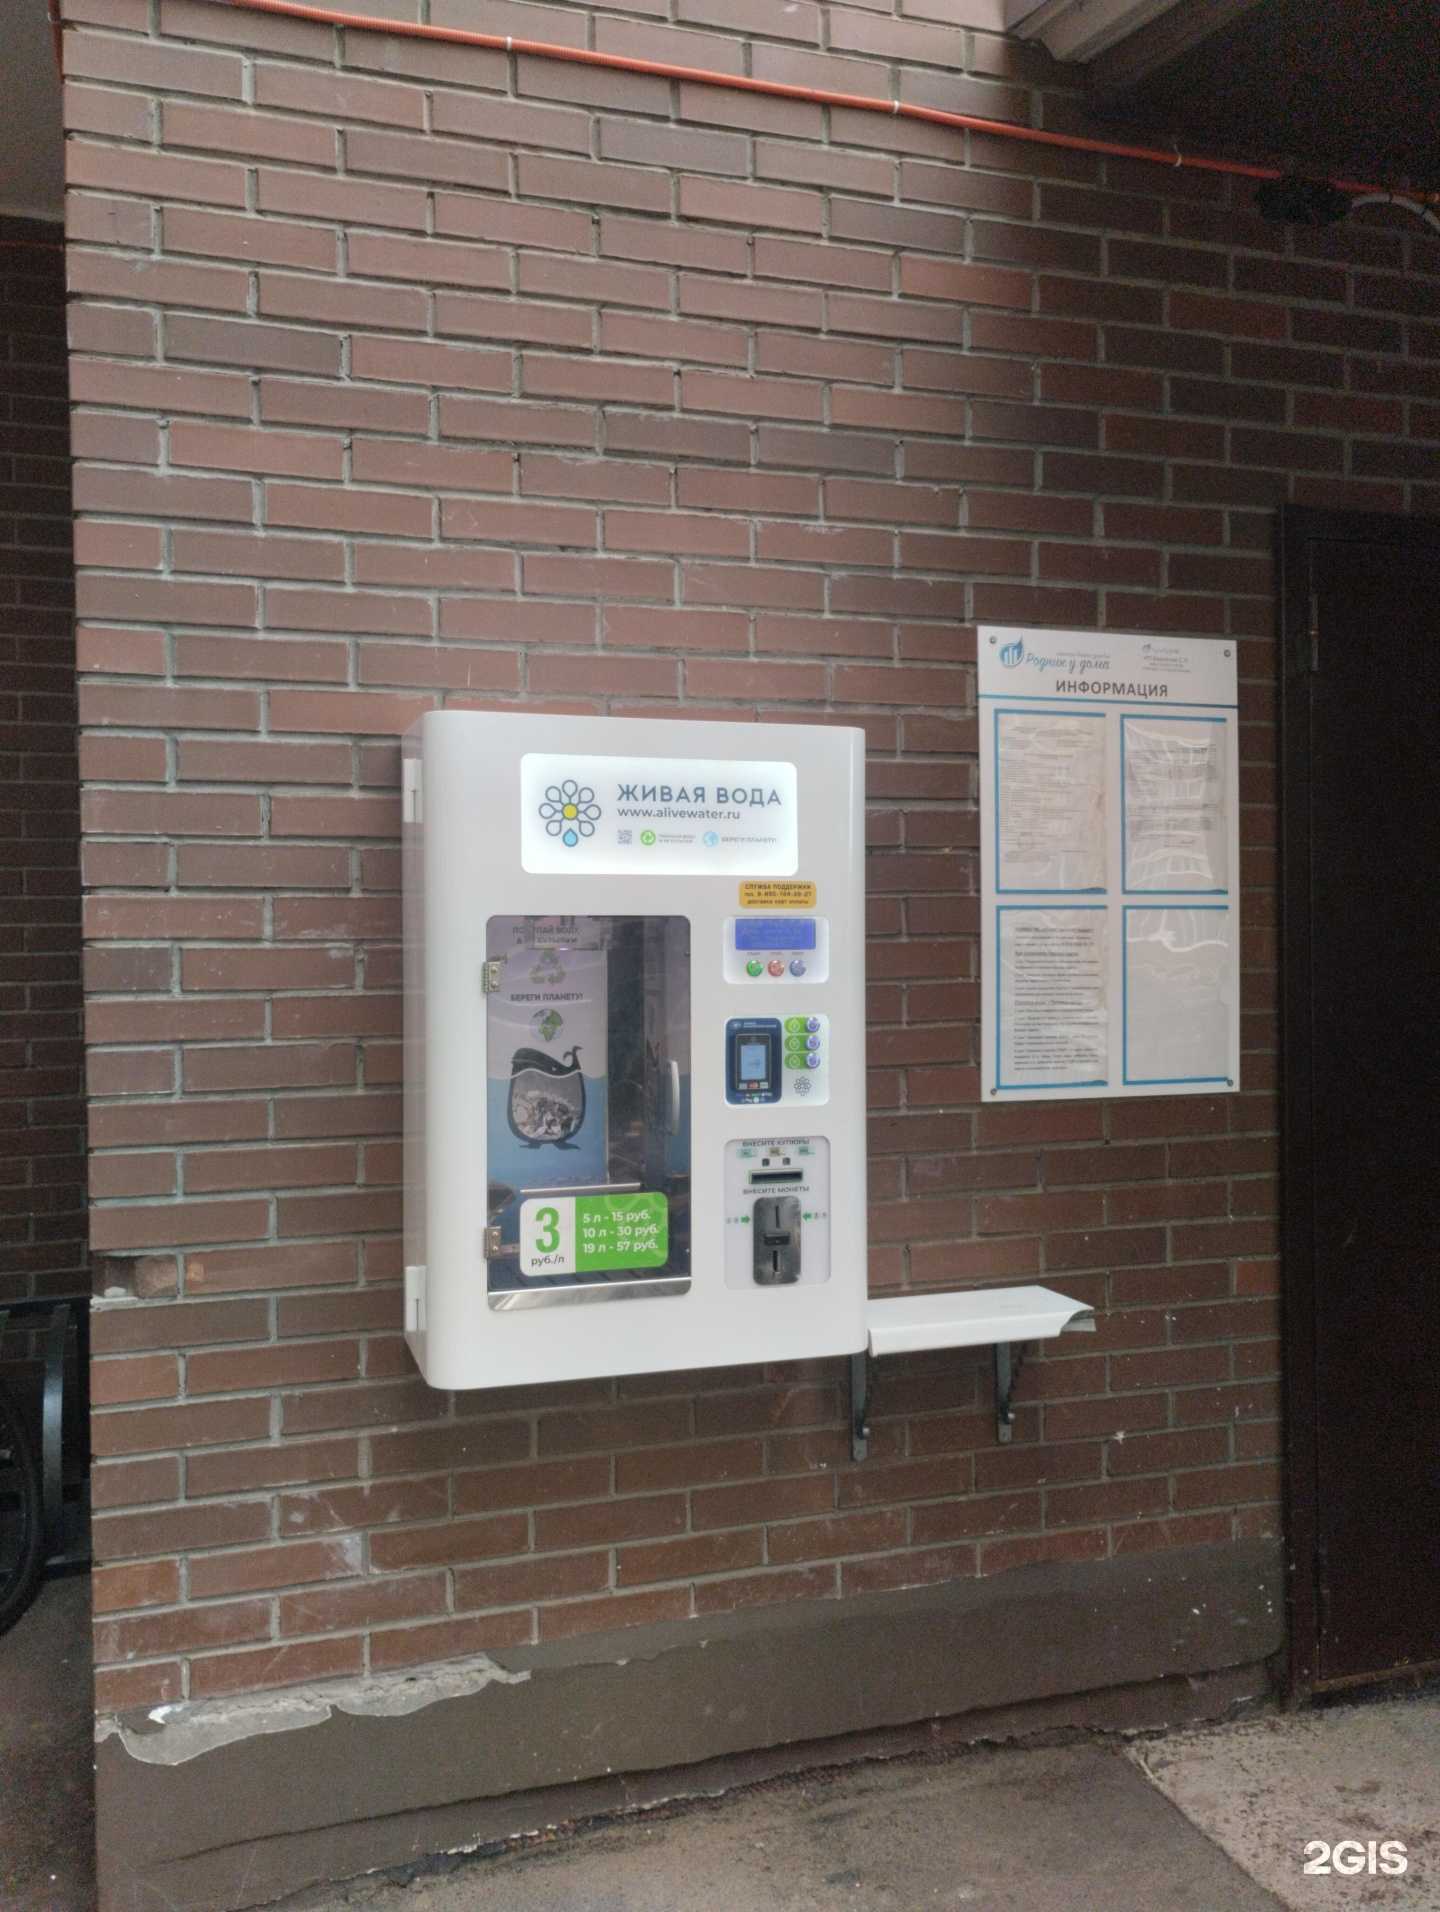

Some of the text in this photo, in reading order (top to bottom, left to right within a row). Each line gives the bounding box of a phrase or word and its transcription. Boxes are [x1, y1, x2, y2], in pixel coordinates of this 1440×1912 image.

[1056, 679, 1169, 699] ИНФОРМАЦИЯ
[617, 783, 782, 808] ЖИВАЯ ВОДА
[617, 807, 741, 820] www.alivewater.ru
[510, 992, 584, 1001] БЕРЕГИ ПЛАНЕТУ!
[583, 1213, 590, 1223] 5
[612, 1211, 623, 1222] 15
[626, 1210, 651, 1223] руб.
[535, 1207, 561, 1253] 3
[583, 1227, 596, 1238] 10
[617, 1225, 632, 1236] 30
[635, 1224, 659, 1237] руб.
[583, 1243, 595, 1254] 19
[616, 1240, 630, 1252] 57
[633, 1239, 658, 1252] руб.
[531, 1254, 565, 1267] руб./л
